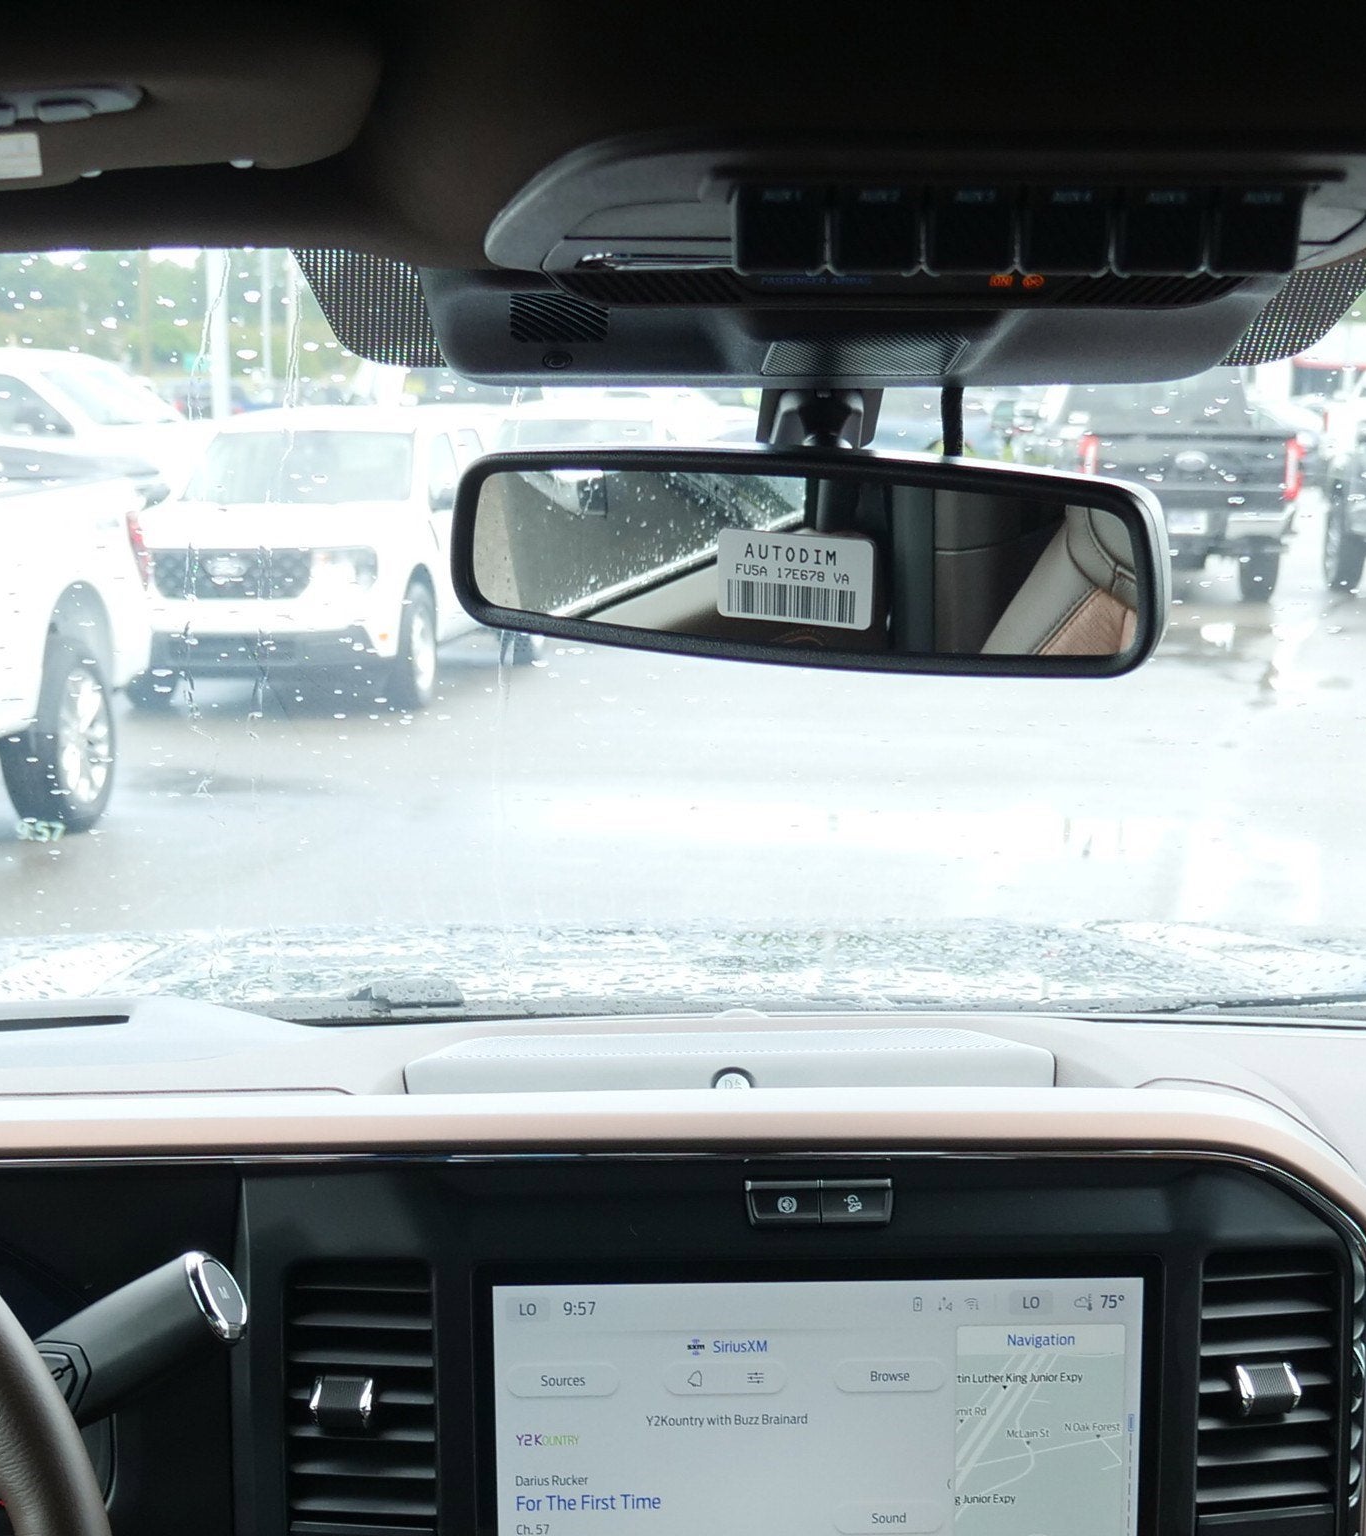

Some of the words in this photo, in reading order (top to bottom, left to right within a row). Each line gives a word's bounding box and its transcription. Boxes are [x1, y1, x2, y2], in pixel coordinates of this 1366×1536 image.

[744, 543, 838, 566] AUTODIM
[777, 567, 826, 583] 17E678
[833, 572, 850, 585] VA
[1022, 1296, 1040, 1309] LO
[1100, 1294, 1125, 1309] 75°
[519, 1302, 537, 1316] LO
[563, 1301, 596, 1316] 9:57
[712, 1340, 768, 1353] SiriusXM
[1007, 1333, 1076, 1348] Navigation
[540, 1374, 586, 1387] Sources
[870, 1370, 910, 1382] Browse
[972, 1373, 1004, 1383] Luther
[1005, 1373, 1028, 1384] King
[1029, 1372, 1058, 1382] Junior
[1060, 1372, 1083, 1384] Expy
[975, 1407, 987, 1416] Rd
[646, 1414, 704, 1428] Y2Kountry
[706, 1414, 731, 1425] with
[734, 1415, 760, 1426] Buzz
[761, 1413, 808, 1425] Brainard
[1073, 1423, 1089, 1431] Oak
[1092, 1422, 1120, 1431] Forest
[1006, 1429, 1038, 1438] McLain
[1040, 1429, 1050, 1437] St
[515, 1475, 550, 1487] Darius
[551, 1475, 588, 1486] Rucker
[516, 1496, 542, 1511] For
[546, 1495, 577, 1511] The
[581, 1494, 617, 1511] First
[620, 1494, 661, 1510] Time
[962, 1495, 991, 1504] Junior
[992, 1493, 1017, 1504] Expy
[871, 1512, 907, 1524] Sound
[516, 1524, 534, 1535] Ch.
[535, 1524, 550, 1535] 57
